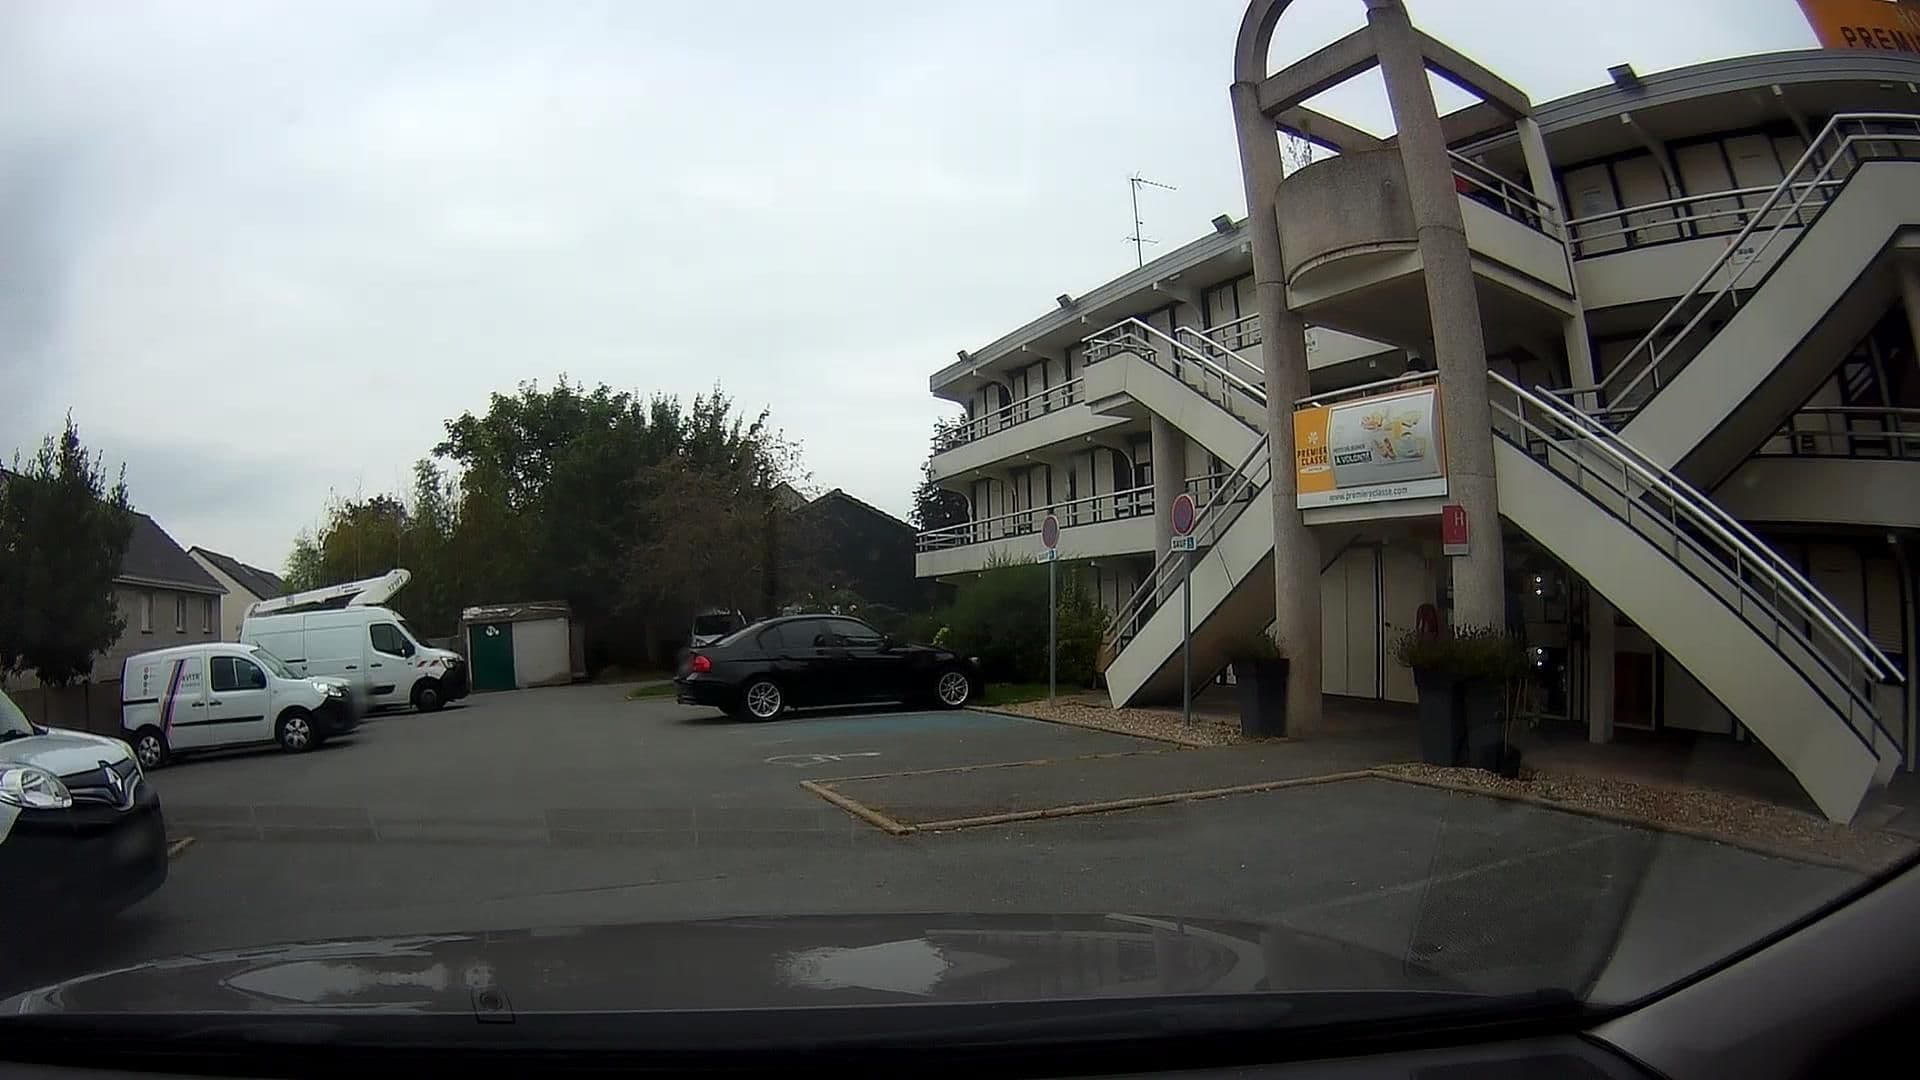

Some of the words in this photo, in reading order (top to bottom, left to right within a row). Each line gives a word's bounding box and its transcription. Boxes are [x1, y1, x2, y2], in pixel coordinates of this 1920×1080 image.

[1297, 446, 1328, 458] PREMIER
[1301, 455, 1328, 466] CLASSE
[1454, 511, 1464, 527] H
